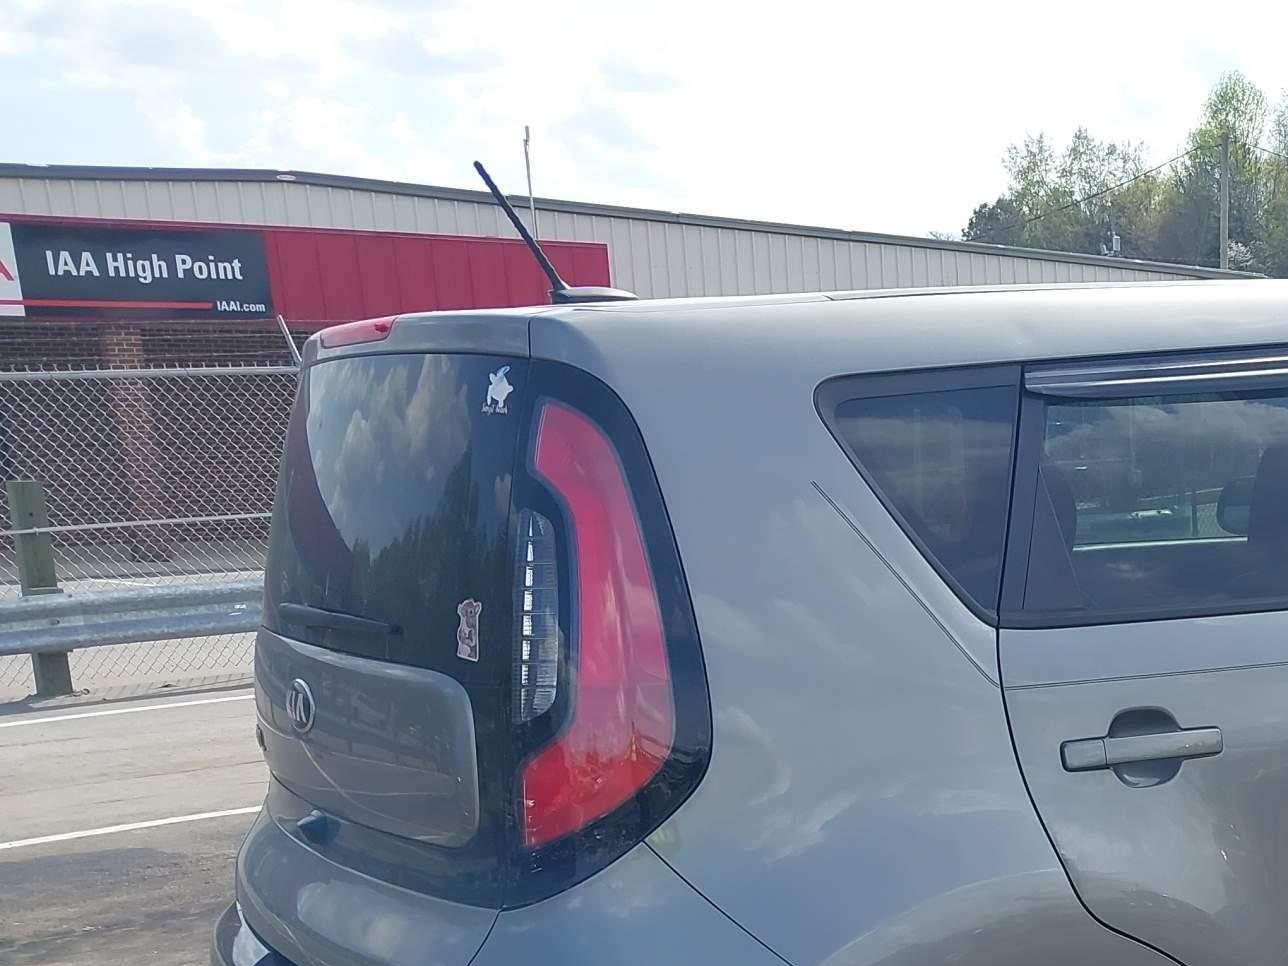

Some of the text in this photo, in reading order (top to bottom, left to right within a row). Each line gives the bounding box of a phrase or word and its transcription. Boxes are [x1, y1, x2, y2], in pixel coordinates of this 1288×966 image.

[45, 250, 100, 277] IAA
[105, 252, 168, 284] High
[175, 254, 243, 280] Point
[216, 300, 266, 313] IAAI.com
